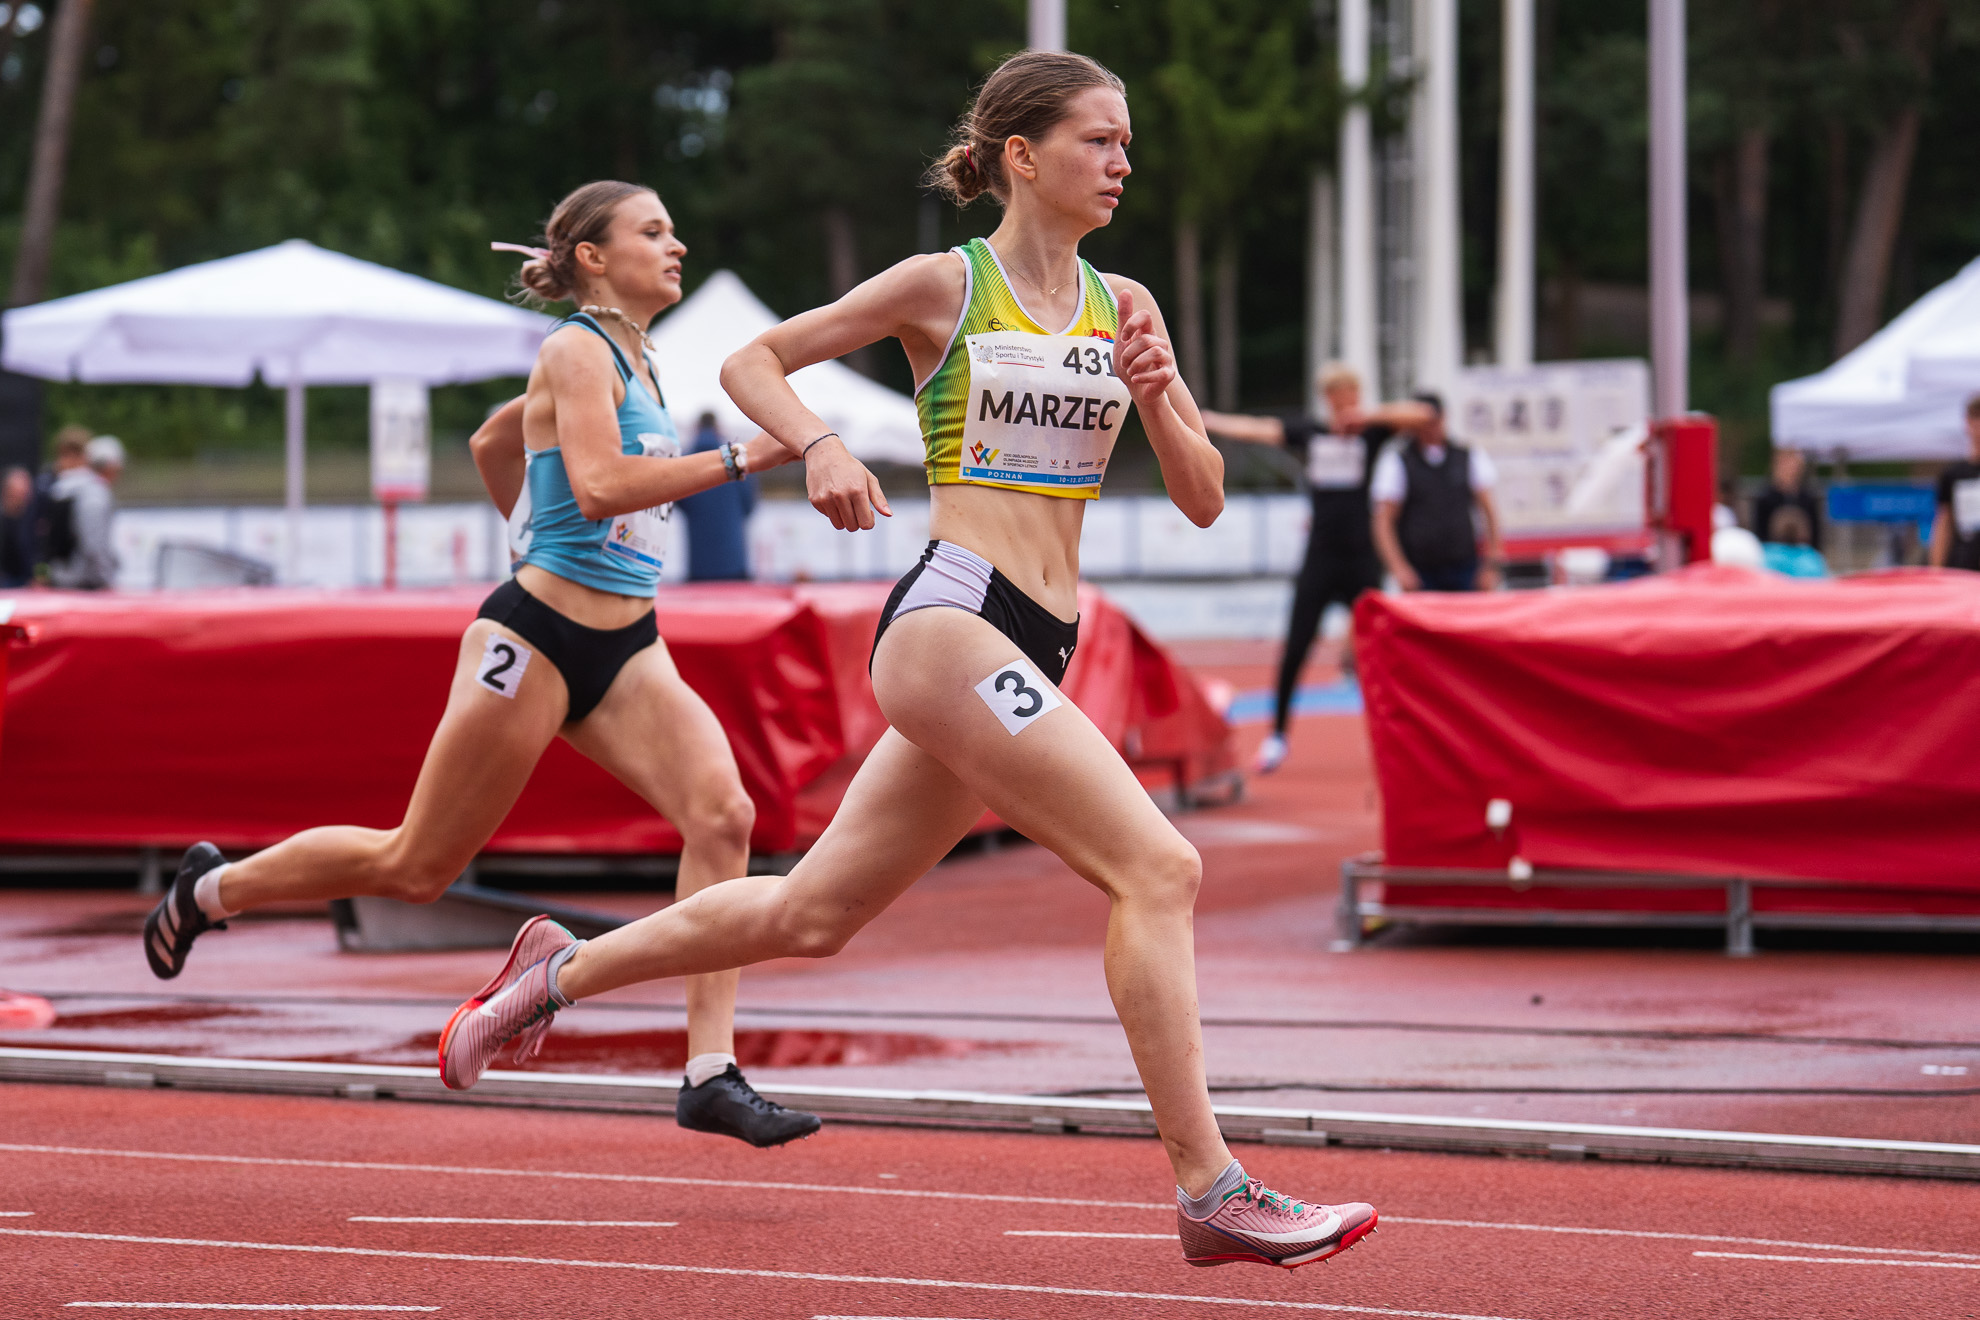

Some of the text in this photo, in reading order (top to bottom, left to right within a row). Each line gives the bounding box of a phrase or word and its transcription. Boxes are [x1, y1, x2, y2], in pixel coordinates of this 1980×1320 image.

[994, 344, 1032, 353] Ministerstwo
[995, 352, 1016, 360] Sportu
[1020, 353, 1045, 362] Turystyki
[1062, 346, 1118, 377] 431
[978, 389, 1121, 431] MARZEC
[987, 471, 1023, 480] POZNAŃ
[482, 642, 517, 692] 2
[994, 669, 1044, 719] 3
